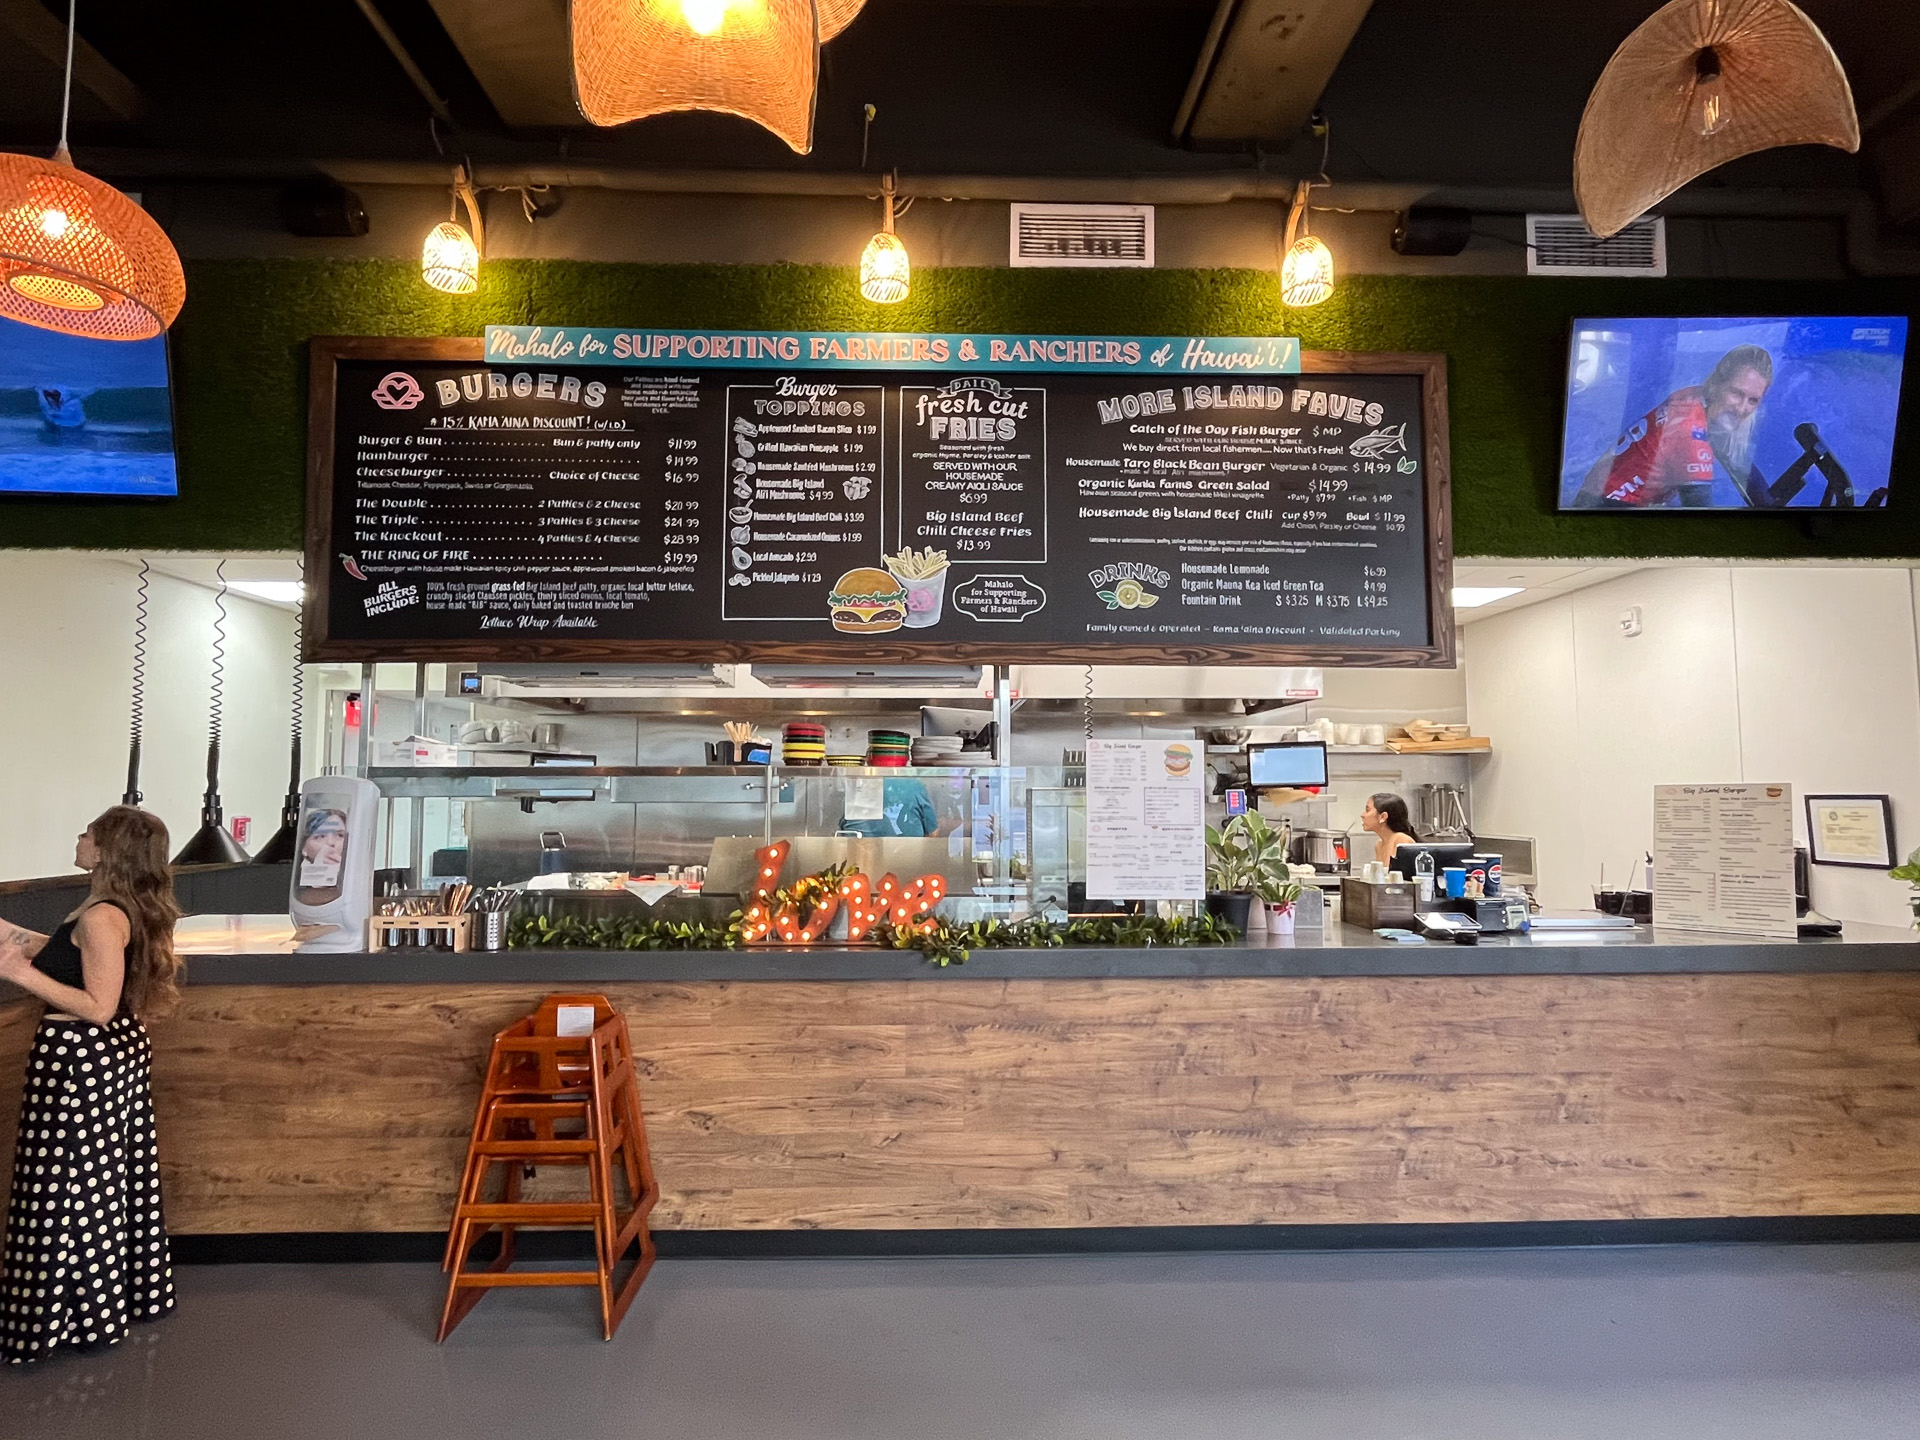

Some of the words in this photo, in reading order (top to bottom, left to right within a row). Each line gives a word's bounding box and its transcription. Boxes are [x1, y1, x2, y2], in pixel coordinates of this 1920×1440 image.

[491, 326, 575, 360] Mahalo
[579, 333, 608, 358] for
[612, 333, 799, 361] SUPPORTING
[809, 337, 950, 362] FARMERS
[959, 339, 979, 362] &
[990, 340, 1141, 364] RANCHERS
[1150, 342, 1173, 367] of
[436, 372, 607, 409] BURGERS
[775, 376, 838, 404] Burger
[954, 380, 997, 390] DAILY
[754, 399, 866, 417] TOPPINGS
[915, 391, 983, 426] fresh
[988, 399, 1029, 419] cut
[1097, 388, 1177, 425] MORE
[1181, 385, 1284, 411] ISLAND
[1291, 389, 1385, 427] FAVES
[442, 416, 464, 428] 15%
[930, 416, 1017, 441] FRIES
[1129, 424, 1165, 434] Catch
[1167, 424, 1181, 435] of
[1183, 425, 1202, 434] the
[1204, 426, 1229, 436] Day
[1231, 425, 1257, 435] Fish
[1259, 426, 1302, 438] Burger
[358, 435, 400, 447] Burger
[404, 435, 413, 446] &
[417, 435, 442, 446] Bun
[553, 438, 575, 447] Bun
[585, 438, 615, 449] patty
[616, 439, 641, 449] only
[757, 443, 779, 452] Grilled
[1122, 443, 1138, 451] We
[1138, 444, 1154, 453] buy
[1156, 444, 1180, 452] direct
[1181, 444, 1201, 452] from
[1202, 444, 1221, 453] local
[1294, 446, 1317, 454] that's
[1318, 446, 1344, 455] Fresh!
[357, 451, 430, 463] Hamburger
[933, 462, 971, 471] SERVED
[972, 462, 995, 471] WITH
[996, 462, 1018, 472] OUR
[1066, 457, 1121, 467] Housemade
[1123, 458, 1151, 468] Taro
[1153, 458, 1187, 469] Black
[1188, 459, 1220, 470] Bean
[1222, 461, 1266, 473] Burger
[1270, 463, 1310, 473] Vegetarian
[1319, 463, 1348, 473] Organic
[356, 466, 445, 479] Cheeseburger
[549, 470, 587, 480] Choice
[588, 471, 600, 482] of
[601, 470, 641, 481] Cheese
[945, 472, 1004, 481] HOUSEMADE
[925, 481, 965, 491] CREAMY
[966, 481, 991, 491] AIOLI
[991, 482, 1024, 491] SAUCE
[1078, 478, 1126, 490] Organic
[1127, 478, 1156, 489] Kunia
[1159, 479, 1194, 489] Farms
[1198, 480, 1234, 490] Green
[1236, 480, 1270, 491] Salad
[355, 498, 379, 508] The
[382, 498, 428, 508] Double
[547, 499, 584, 509] Patties
[603, 500, 641, 509] Cheese
[354, 514, 378, 524] The
[381, 514, 419, 526] Triple
[547, 517, 584, 526] Patties
[603, 517, 641, 526] Cheese
[926, 510, 947, 523] Big
[950, 511, 991, 522] Island
[994, 512, 1024, 524] Beef
[1079, 507, 1150, 519] Housemade
[1152, 507, 1172, 520] Big
[1173, 507, 1211, 519] Island
[1214, 508, 1241, 521] Beef
[1245, 509, 1273, 520] Chili
[1281, 512, 1301, 521] Cup
[1346, 512, 1370, 521] Bowl
[354, 531, 378, 541] The
[380, 531, 442, 542] Knockout
[546, 534, 583, 543] Patties
[603, 534, 641, 543] Cheese
[917, 525, 947, 536] Chili
[950, 525, 997, 537] Cheese
[999, 526, 1033, 537] Fries
[360, 550, 384, 560] THE
[387, 550, 420, 560] RING
[423, 550, 439, 560] OF
[442, 550, 470, 560] FIRE
[1088, 561, 1171, 589] DRINKS
[1181, 563, 1228, 574] Housemade
[1229, 563, 1270, 574] Lemonade
[378, 580, 399, 594] ALL
[446, 582, 465, 591] fresh
[466, 582, 490, 592] ground
[491, 581, 525, 593] grass-fed
[540, 582, 561, 591] Island
[600, 583, 626, 592] organic
[646, 582, 666, 591] butter
[669, 582, 695, 592] lettuce,
[984, 580, 1014, 588] Mahalo
[1181, 578, 1213, 592] Organic
[1216, 579, 1243, 590] Mauna
[1245, 580, 1261, 591] Kea
[1263, 580, 1281, 591] Iced
[1283, 580, 1308, 591] Green
[1309, 580, 1325, 591] Tea
[363, 585, 418, 608] BURGERS
[426, 592, 453, 601] crunchy
[455, 591, 475, 600] sliced
[477, 591, 507, 600] Claussen
[984, 589, 1027, 598] Supporting
[366, 595, 420, 617] INCLUDE:
[960, 597, 993, 605] Farmers
[1001, 597, 1038, 605] Ranchers
[1181, 594, 1217, 606] Fountain
[1220, 595, 1242, 606] Drink
[1275, 595, 1282, 606] S
[1315, 595, 1323, 606] M
[1357, 595, 1363, 607] L
[980, 605, 990, 613] of
[990, 605, 1018, 613] Hawaii
[479, 615, 513, 630] Lettuce
[515, 615, 549, 630] Wrap
[552, 614, 599, 628] Available
[1086, 623, 1117, 633] Family
[1119, 624, 1150, 632] owned
[1159, 624, 1200, 634] Operated
[1212, 625, 1240, 634] Kama
[1265, 626, 1306, 635] Discount
[1319, 626, 1363, 636] Validated
[1365, 627, 1401, 638] Parking
[741, 838, 950, 943] love
